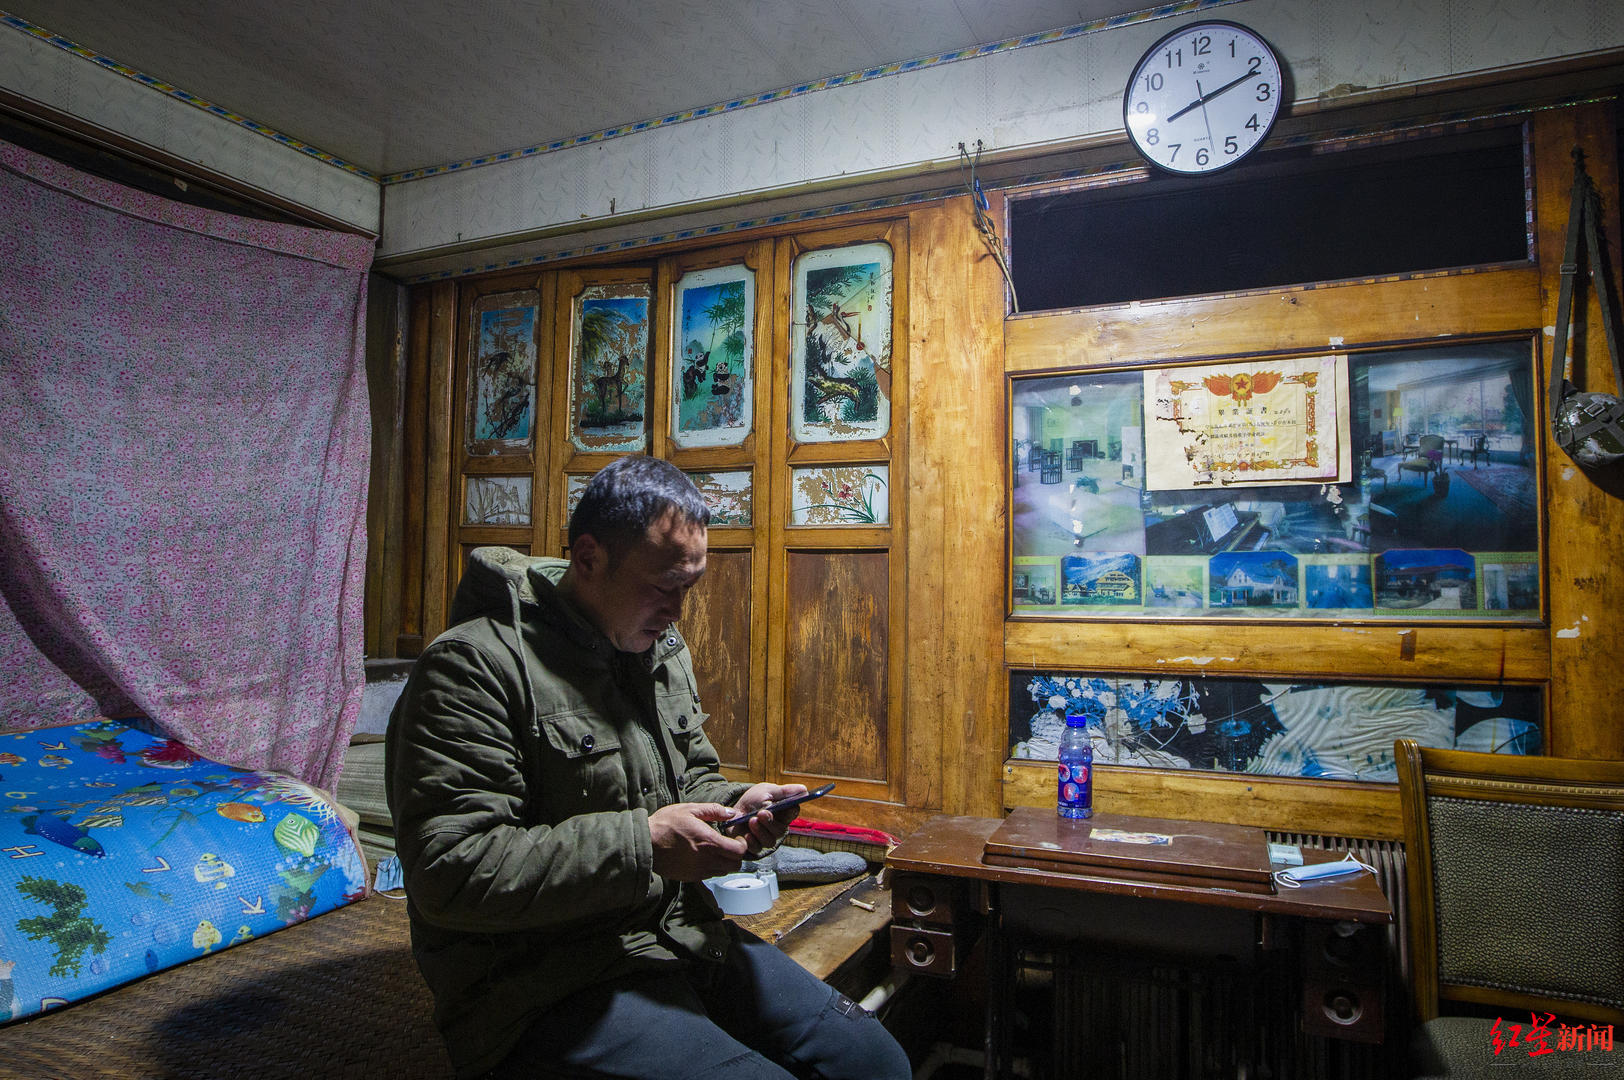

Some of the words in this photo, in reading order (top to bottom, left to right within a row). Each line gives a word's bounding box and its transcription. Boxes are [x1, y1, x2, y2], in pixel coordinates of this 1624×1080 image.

[1192, 36, 1212, 56] 12
[1228, 39, 1235, 58] 1
[1165, 48, 1182, 69] 11
[1247, 56, 1262, 75] 2
[1144, 72, 1164, 92] 10
[1256, 82, 1271, 102] 3
[1244, 113, 1260, 132] 4
[1146, 127, 1160, 146] 8
[1223, 135, 1238, 155] 5
[1167, 143, 1182, 163] 7
[1195, 148, 1210, 166] 6
